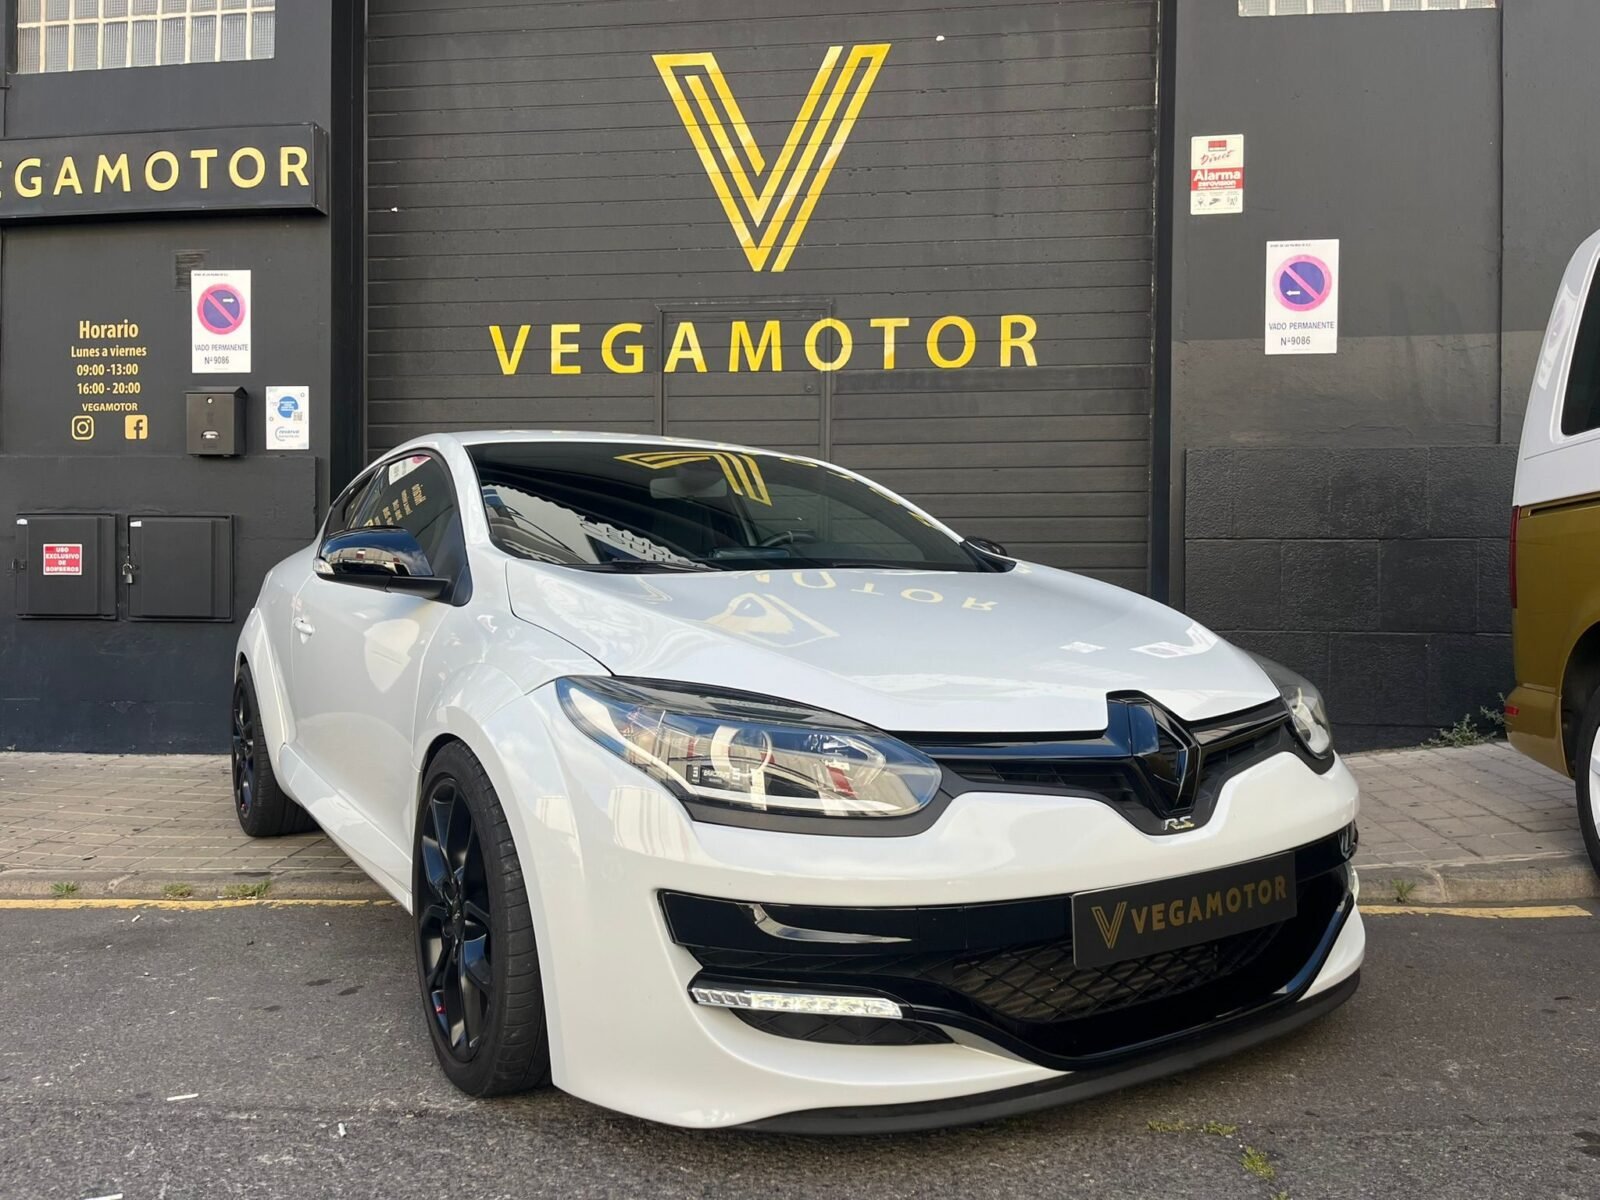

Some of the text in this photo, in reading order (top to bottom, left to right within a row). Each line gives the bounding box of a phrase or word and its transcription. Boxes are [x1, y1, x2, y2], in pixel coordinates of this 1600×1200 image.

[0, 146, 310, 198] GAMOTOR
[1193, 169, 1241, 182] Alarma
[79, 318, 139, 339] Horario
[1268, 320, 1335, 331] VADO PERMANENTE
[71, 344, 147, 358] Lunes a viernes
[194, 343, 249, 352] VADO PERMANENTE
[489, 313, 1038, 376] VEGAMOTOR
[76, 363, 105, 376] 09:00
[77, 382, 105, 395] 16:00
[112, 381, 141, 394] 20:00
[81, 402, 138, 412] VEGAMOTOR
[1164, 815, 1195, 831] RS
[1130, 875, 1287, 935] VEGAMOTOR
